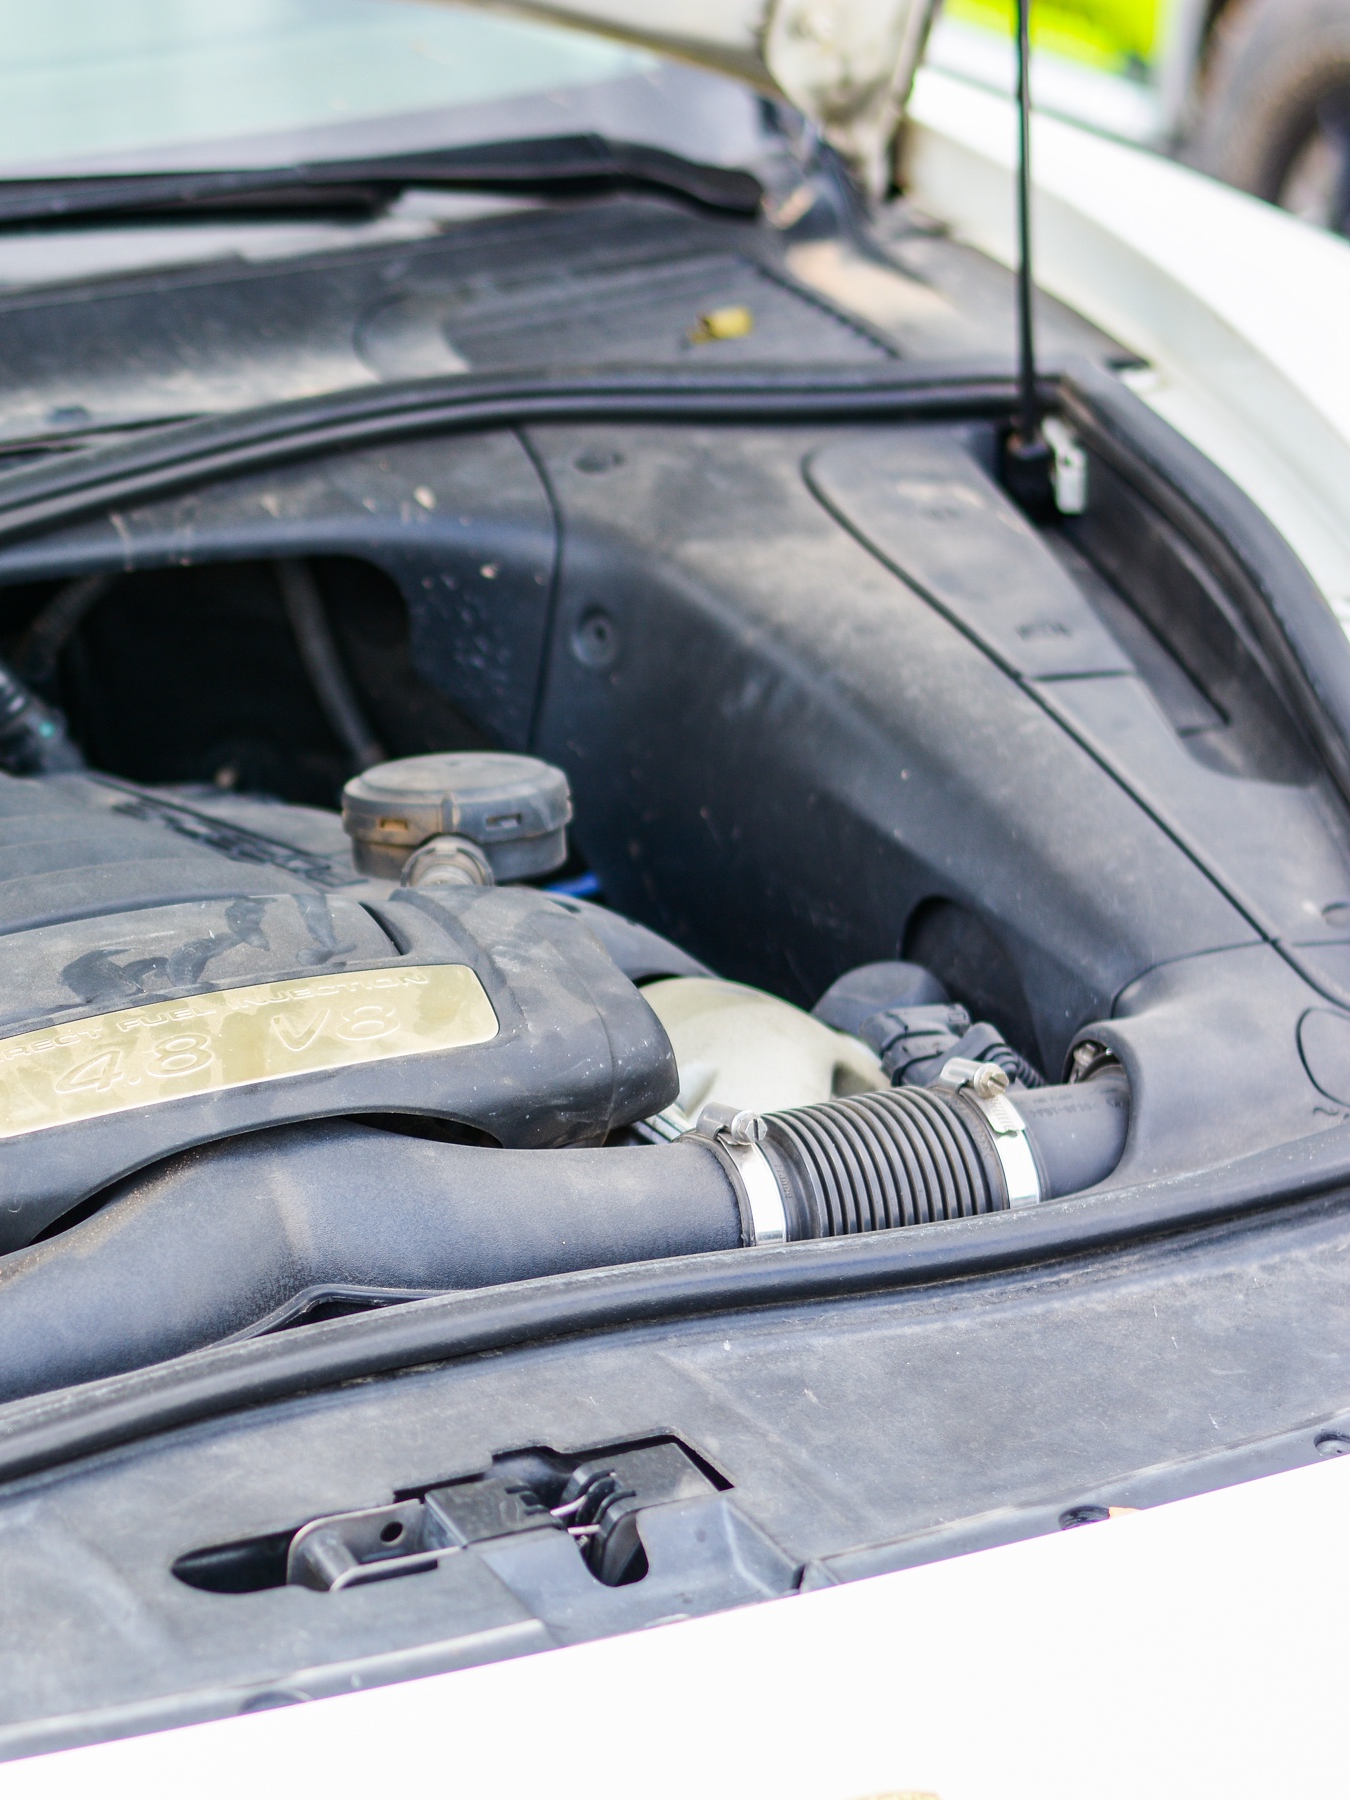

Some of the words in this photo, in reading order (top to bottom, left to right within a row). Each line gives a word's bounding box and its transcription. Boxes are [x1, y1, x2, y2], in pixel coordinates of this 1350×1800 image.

[116, 1006, 217, 1033] FUEL
[224, 973, 430, 1011] INJECTION
[54, 1033, 217, 1095] 4.8
[271, 1005, 400, 1051] V8
